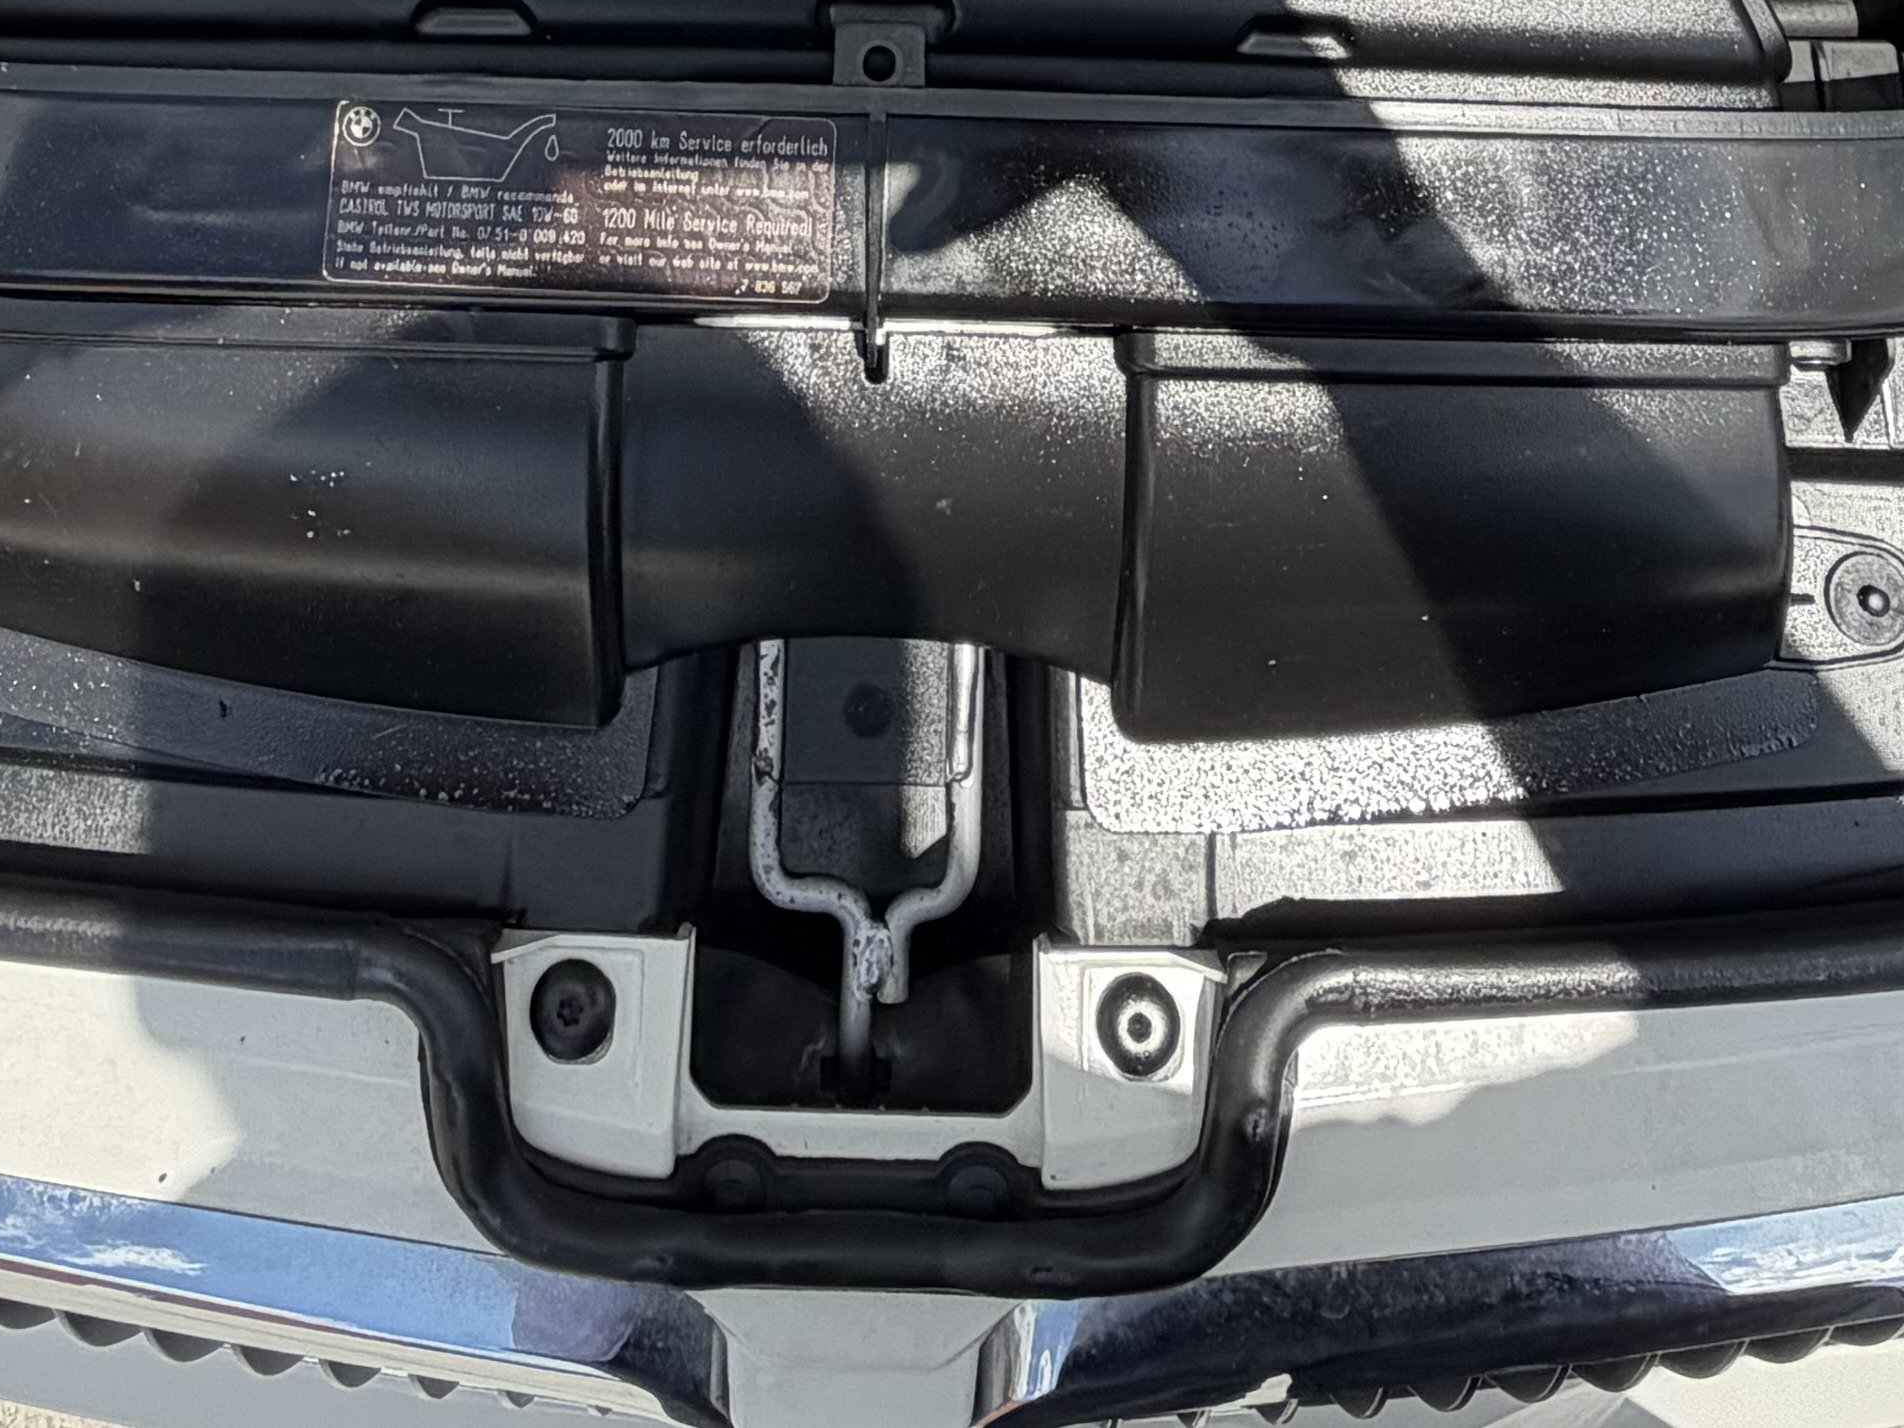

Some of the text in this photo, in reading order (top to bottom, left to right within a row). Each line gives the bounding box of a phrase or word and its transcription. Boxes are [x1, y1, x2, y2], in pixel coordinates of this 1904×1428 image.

[607, 128, 828, 157] 2000 km Service erforderlich
[341, 180, 371, 195] BMW
[378, 183, 439, 198] empfiehlt
[461, 185, 491, 199] BMW
[339, 197, 389, 216] CASTROL
[397, 200, 420, 217] TWS
[425, 201, 496, 220] MOTORSPORT
[502, 204, 523, 222] SAE
[602, 208, 637, 229] 1200
[644, 208, 675, 231] Mile
[683, 210, 737, 234] Service
[337, 219, 364, 234] BMW
[563, 229, 586, 245] 420
[599, 232, 619, 246] For
[625, 236, 651, 248] more
